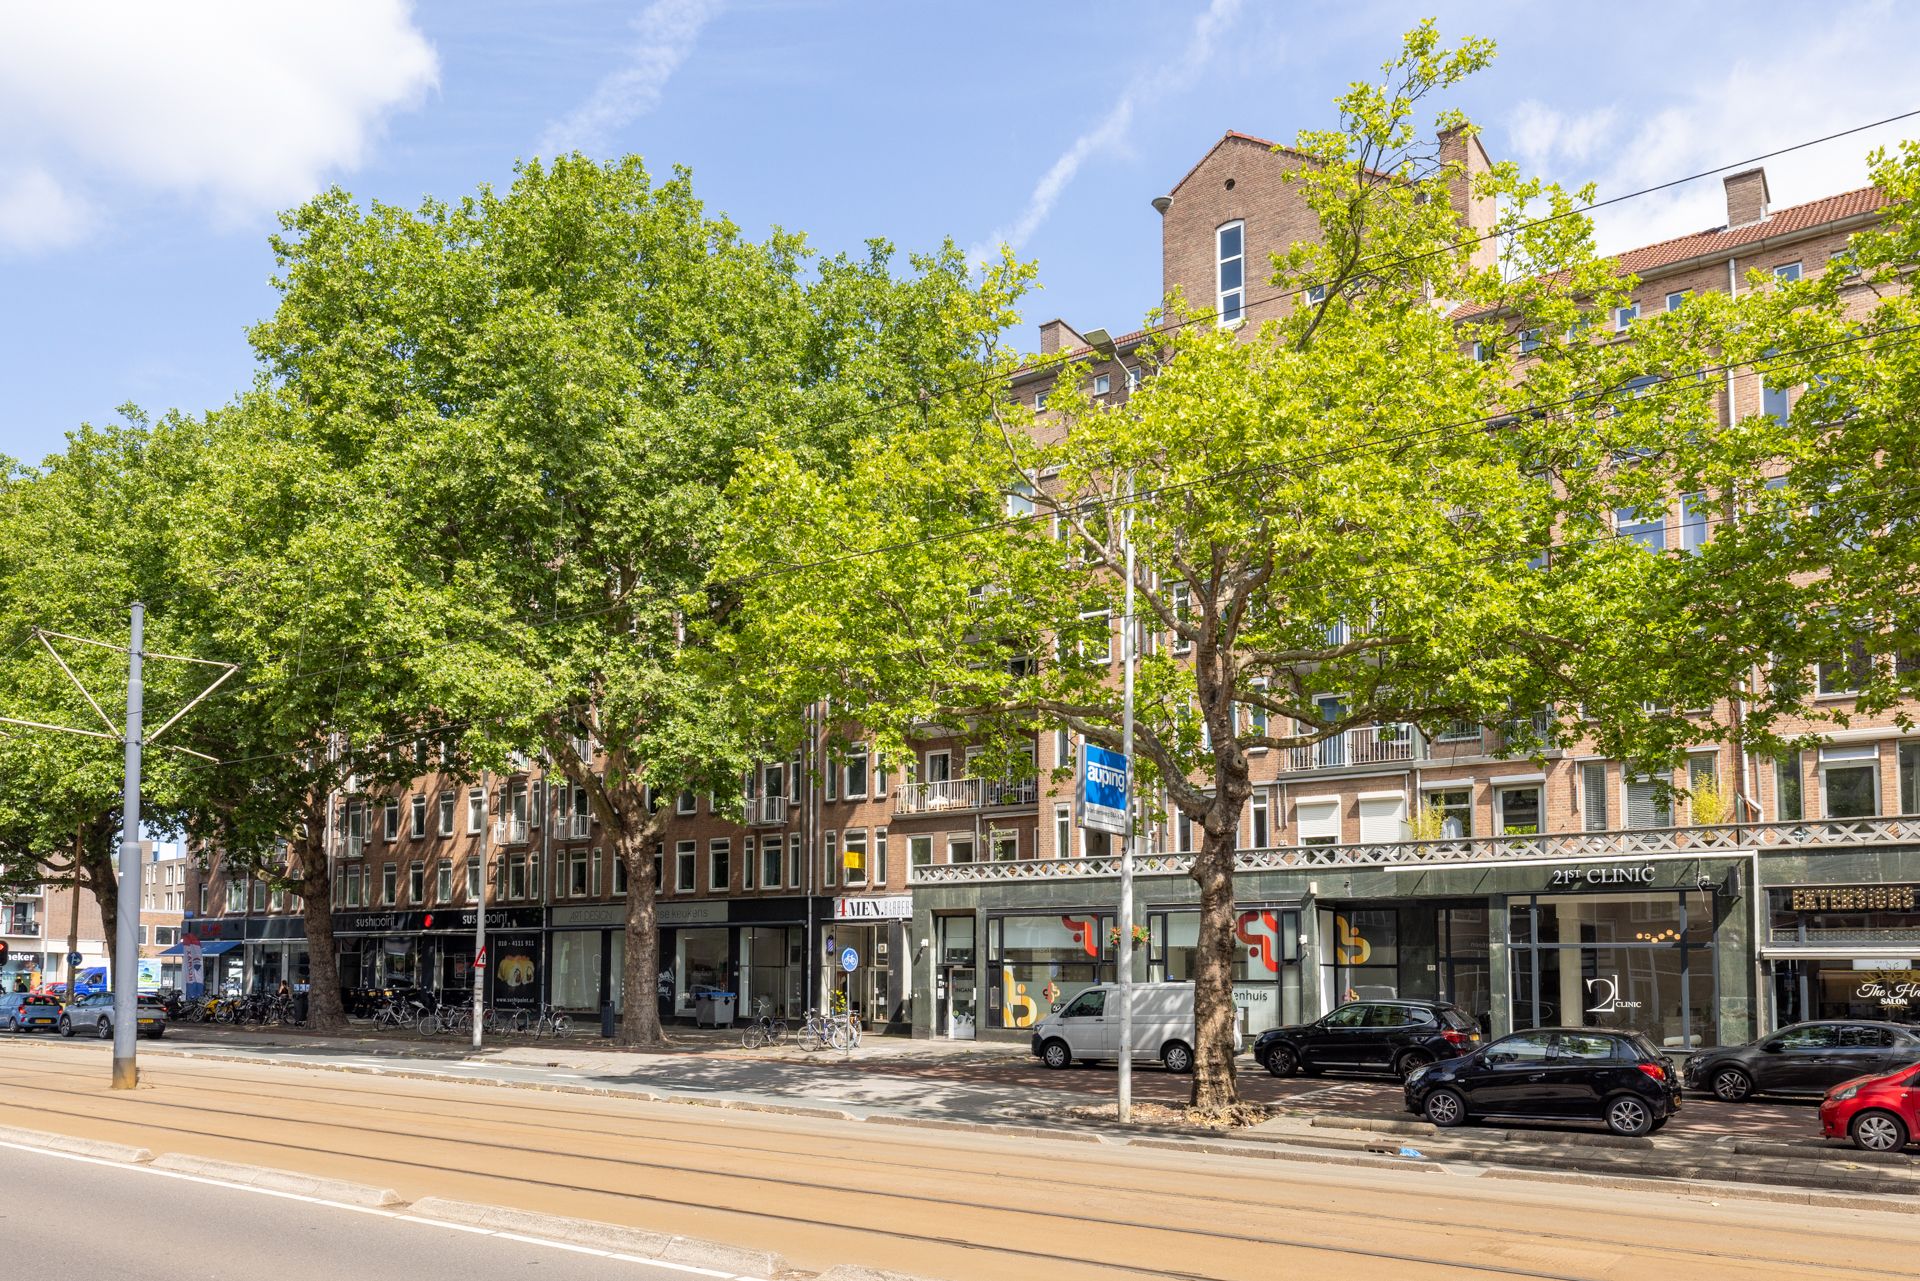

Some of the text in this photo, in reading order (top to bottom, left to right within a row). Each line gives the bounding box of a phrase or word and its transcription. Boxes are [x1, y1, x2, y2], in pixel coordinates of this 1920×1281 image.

[1087, 765, 1125, 793] auping
[1553, 867, 1656, 884] 21ST CLINIC
[1793, 886, 1915, 910] EXTENSIONS
[462, 911, 508, 926] suspoint
[584, 910, 613, 921] DESIGN
[672, 908, 709, 919] keukens
[356, 914, 395, 930] sushipoint
[1856, 983, 1886, 998] The
[1880, 997, 1908, 1005] SALON
